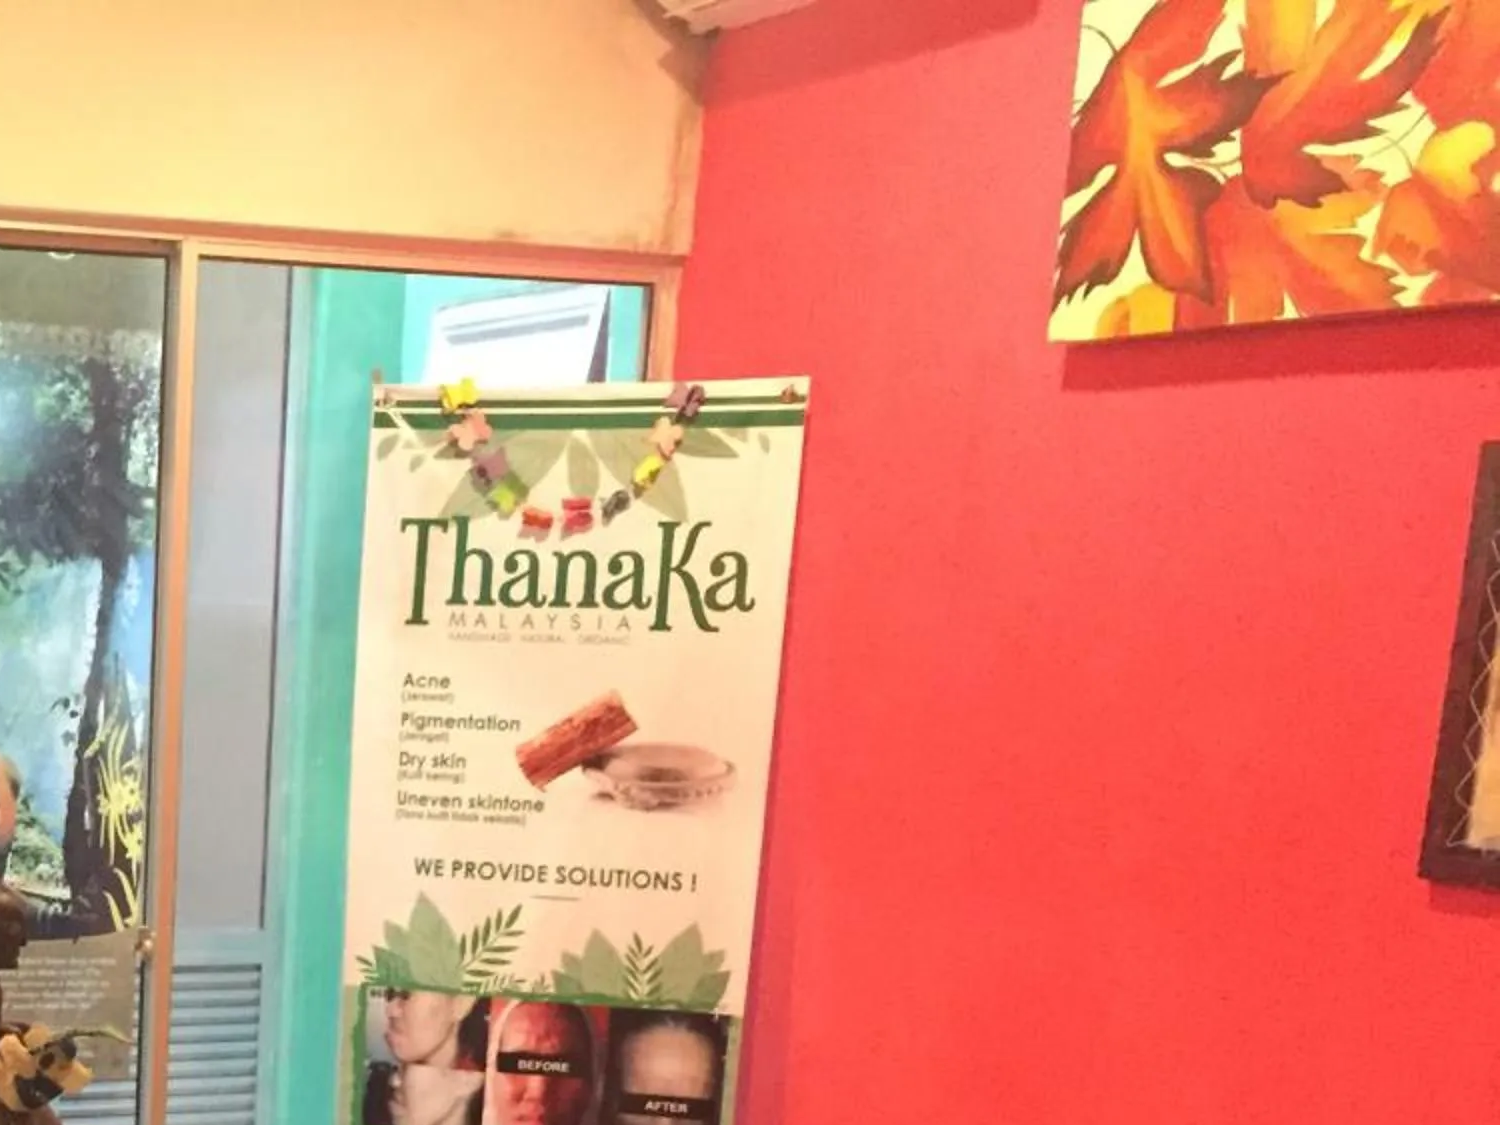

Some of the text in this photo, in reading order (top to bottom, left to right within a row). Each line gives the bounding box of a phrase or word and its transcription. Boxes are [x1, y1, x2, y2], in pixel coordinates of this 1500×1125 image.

[449, 612, 632, 631] MALAYSIA
[403, 673, 451, 689] Acne
[401, 712, 521, 731] Pigmentation
[399, 751, 467, 770] Dry skin
[397, 791, 546, 812] Uneven skintone
[414, 857, 445, 877] WE
[451, 860, 548, 883] PROVIDE
[555, 866, 683, 892] SOLUTIONS
[517, 1058, 571, 1074] BEFORE
[643, 1100, 689, 1114] AFTER
